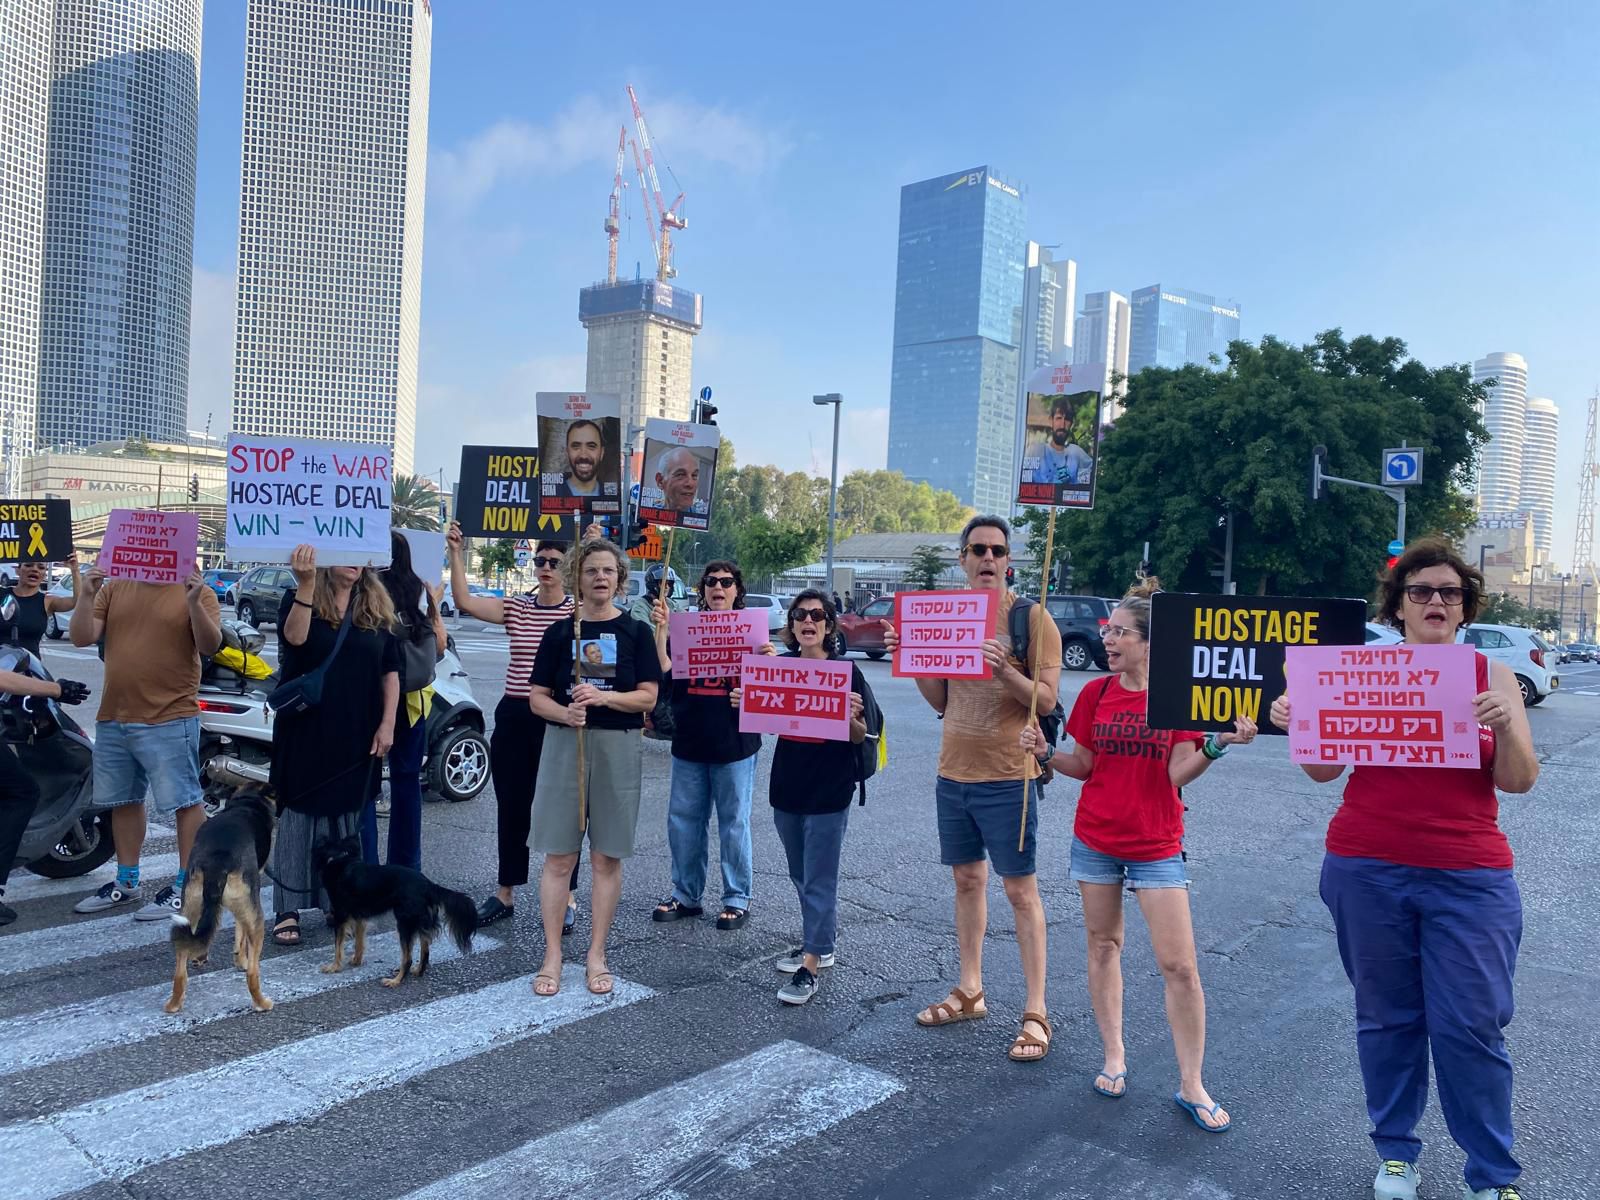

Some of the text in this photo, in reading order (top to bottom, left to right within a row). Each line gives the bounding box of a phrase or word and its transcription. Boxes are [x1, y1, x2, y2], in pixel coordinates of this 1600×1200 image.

[968, 171, 985, 186] EY
[230, 444, 388, 481] STOP the WAR
[541, 472, 564, 484] BRING
[88, 481, 152, 493] MANGO
[231, 481, 389, 509] HOSTAGE DEAL
[485, 480, 531, 503] DEAL
[541, 484, 557, 496] HIM
[0, 505, 47, 521] STAGE
[130, 512, 165, 523] לחימה
[482, 507, 530, 532] NOW
[118, 523, 178, 536] לא מחזירה
[233, 513, 279, 536] WIN
[313, 515, 364, 538] WIN
[115, 549, 174, 565] רק עסקה
[110, 566, 177, 581] תציל חיים
[911, 601, 978, 616] רק עסקה!
[700, 613, 739, 623] לחימה
[1193, 607, 1320, 644] HOSTAGE
[688, 624, 752, 635] לא מחזירה
[911, 628, 976, 642] רק עסקה!
[691, 651, 729, 662] עסקה
[911, 655, 975, 669] רק עסקה!
[1192, 646, 1263, 680] DEAL
[1341, 648, 1414, 665] לחימה
[689, 665, 742, 677] ציל חיים
[814, 669, 848, 689] קול
[1318, 669, 1440, 686] לא מחזירה
[750, 690, 841, 713] זועק אלי
[1191, 686, 1262, 723] NOW
[1325, 716, 1438, 736] רק עסקה
[1320, 743, 1445, 764] תציל חיים
